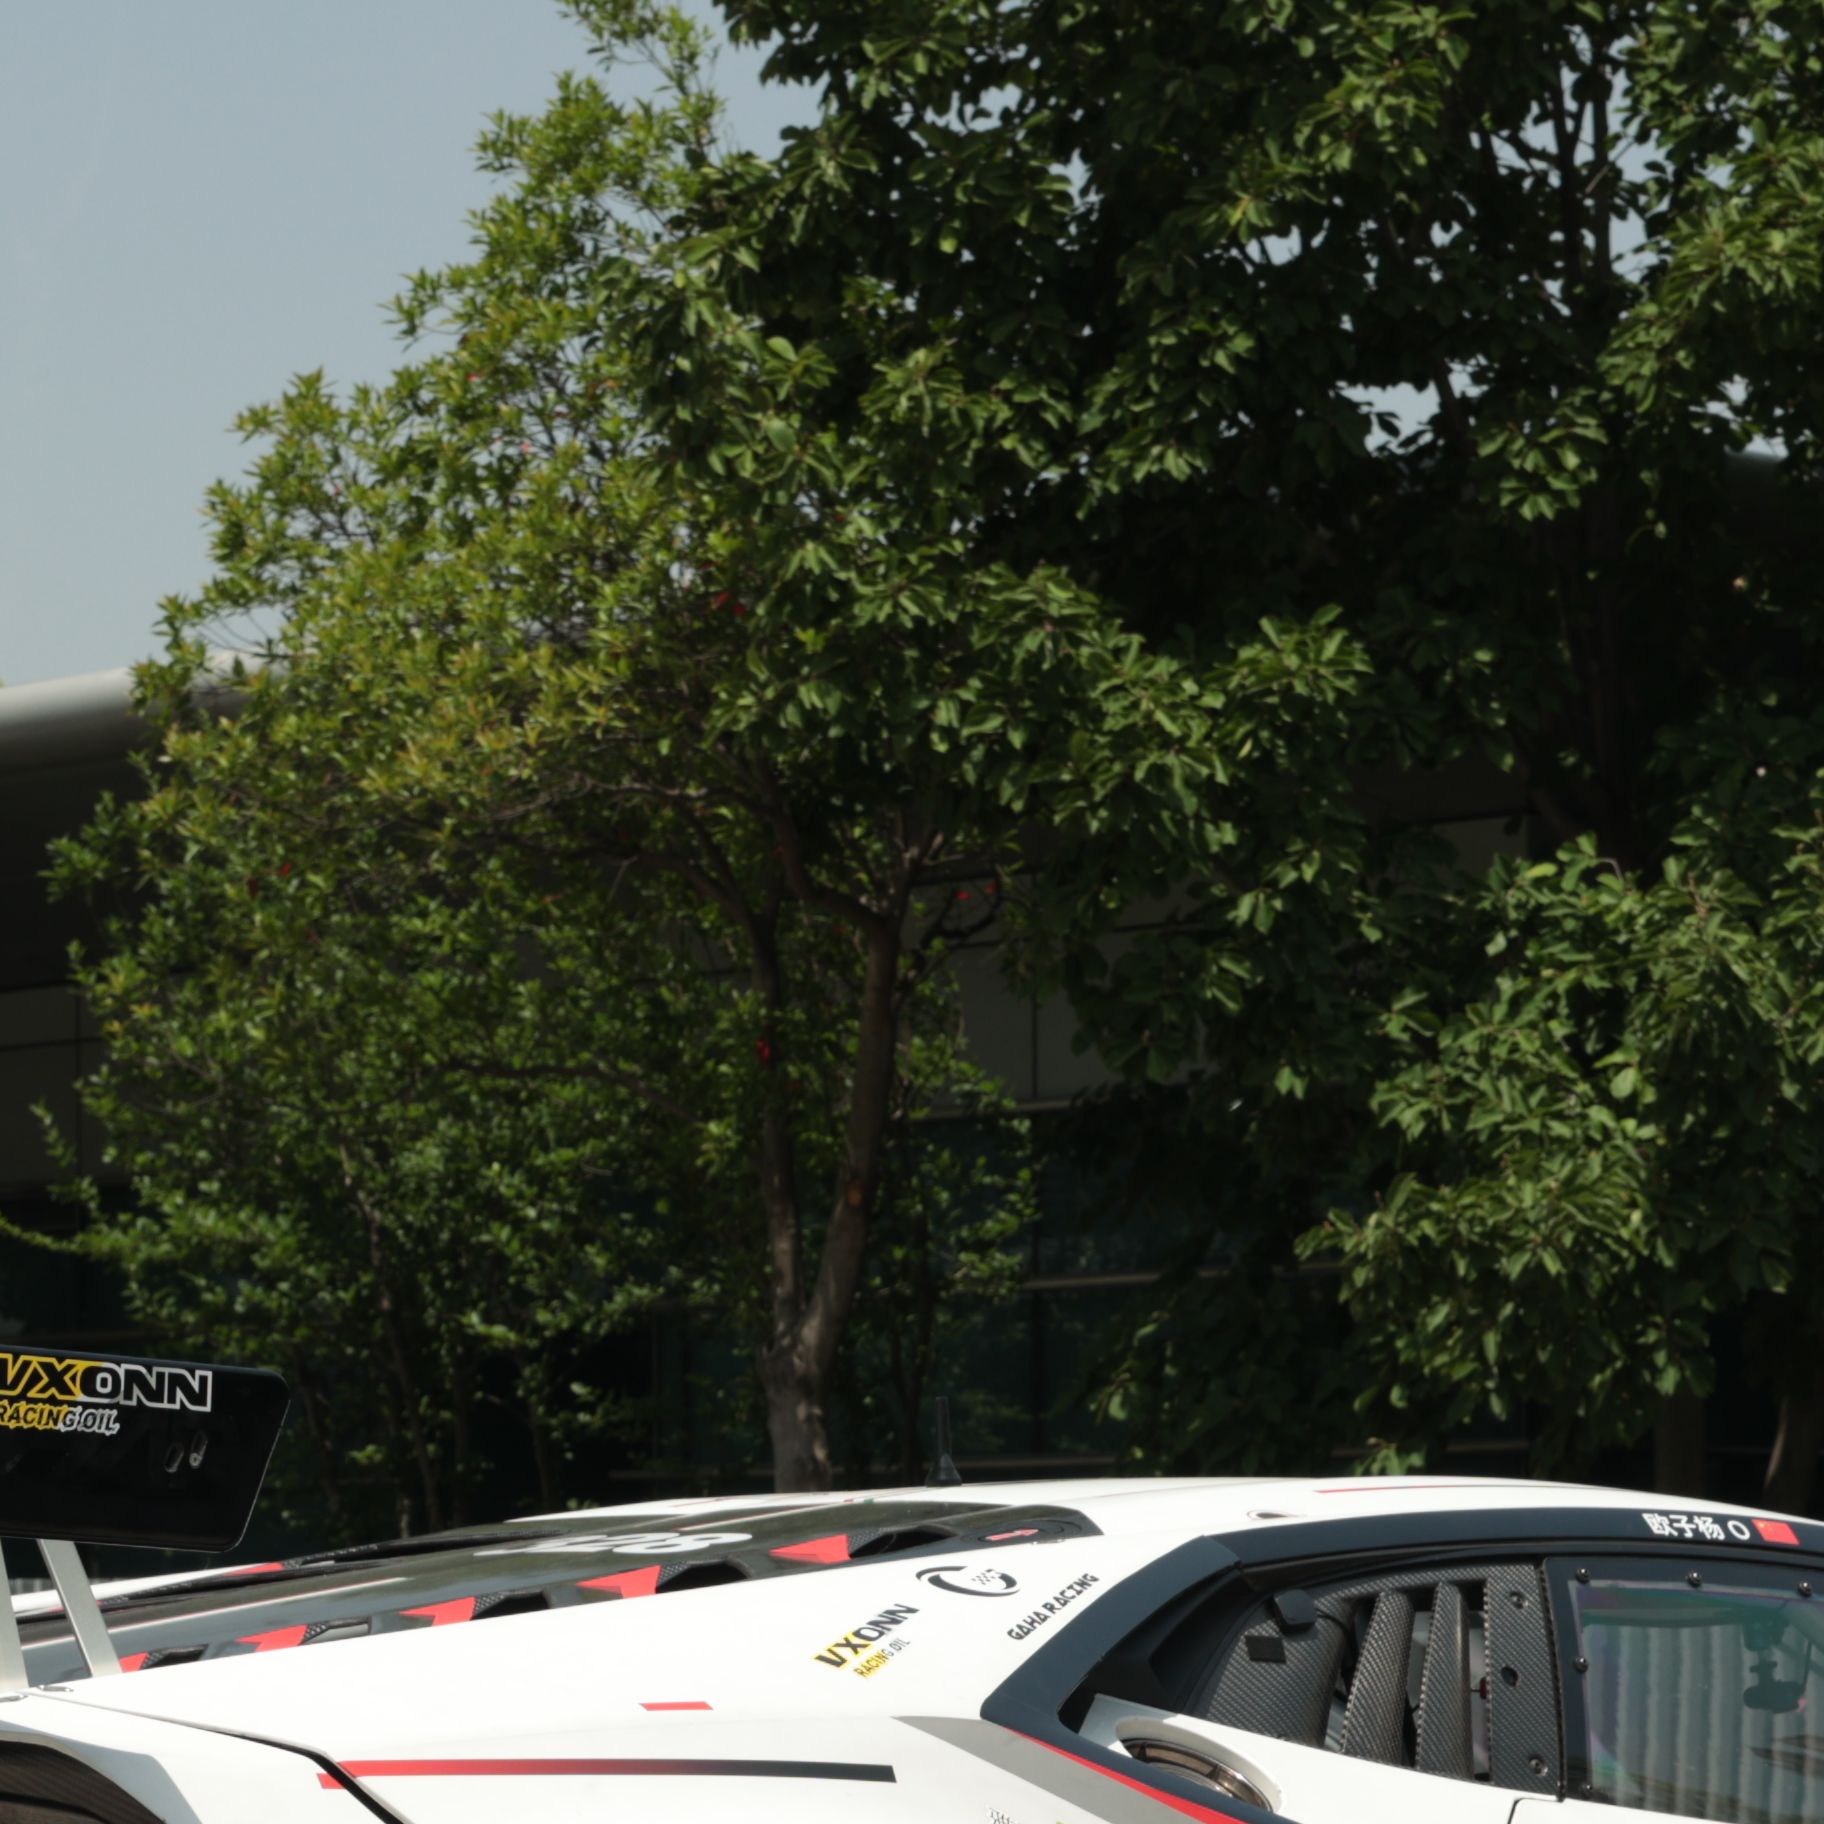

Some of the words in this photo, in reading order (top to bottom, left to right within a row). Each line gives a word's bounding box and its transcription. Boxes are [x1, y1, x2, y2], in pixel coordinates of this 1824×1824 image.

[78, 1408, 121, 1435] OIL
[1007, 1611, 1051, 1641] GAHA
[1042, 1573, 1100, 1615] RACING
[813, 1603, 920, 1669] VXONN
[852, 1648, 894, 1679] RACING
